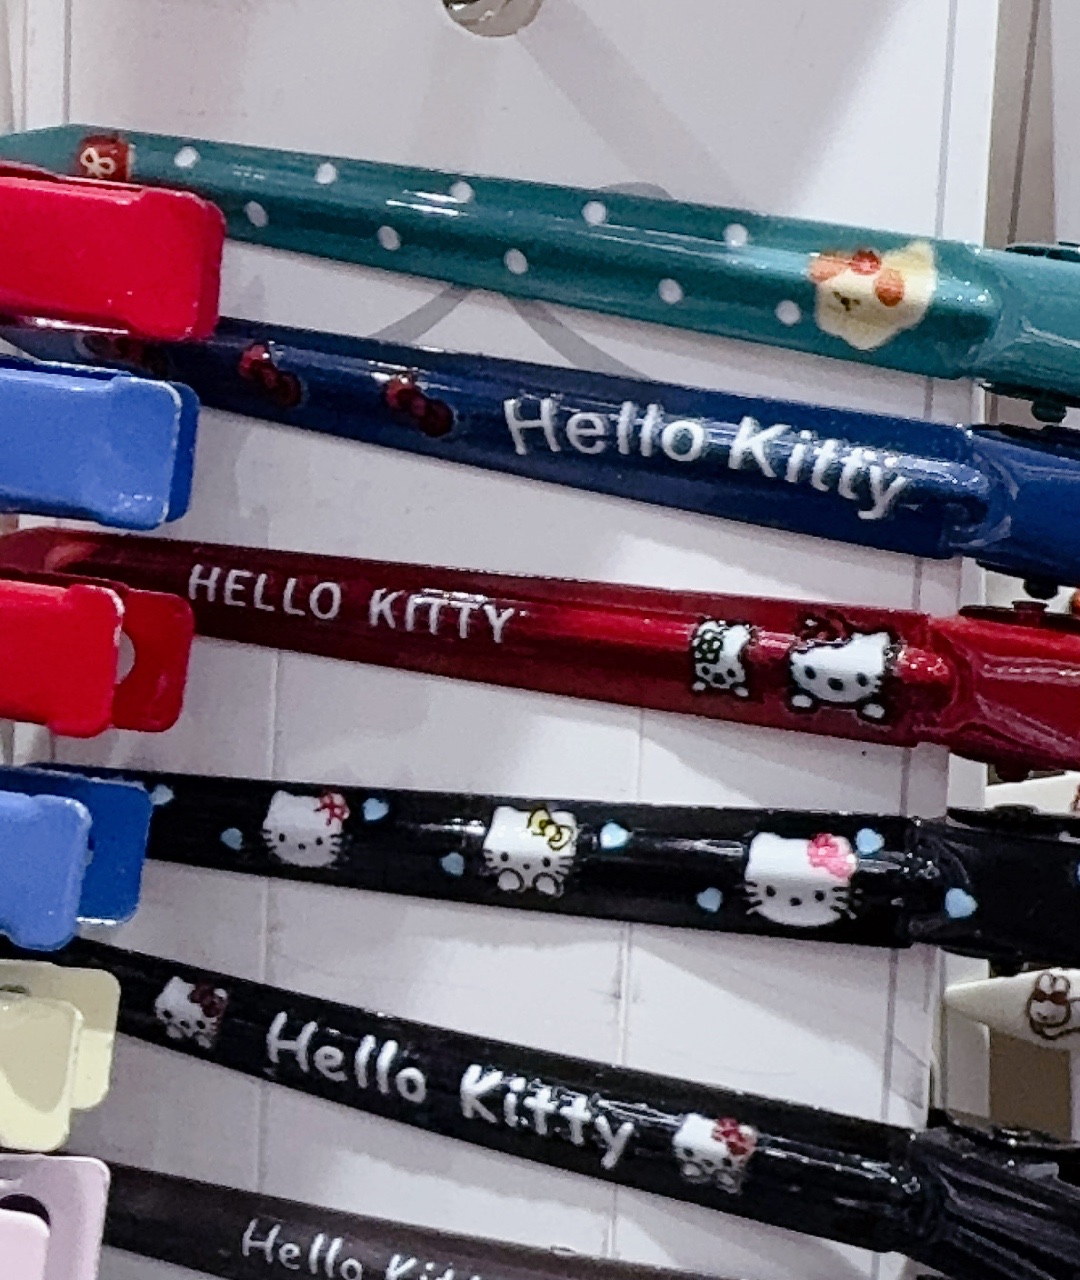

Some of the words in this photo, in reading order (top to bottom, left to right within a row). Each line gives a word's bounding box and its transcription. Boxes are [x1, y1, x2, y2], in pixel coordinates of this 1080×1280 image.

[503, 397, 706, 463] Hello
[728, 416, 907, 520] Kitty
[188, 564, 342, 620] HELLO
[368, 588, 515, 644] KITTY
[266, 1011, 427, 1105] Hello
[459, 1063, 635, 1171] Kitty
